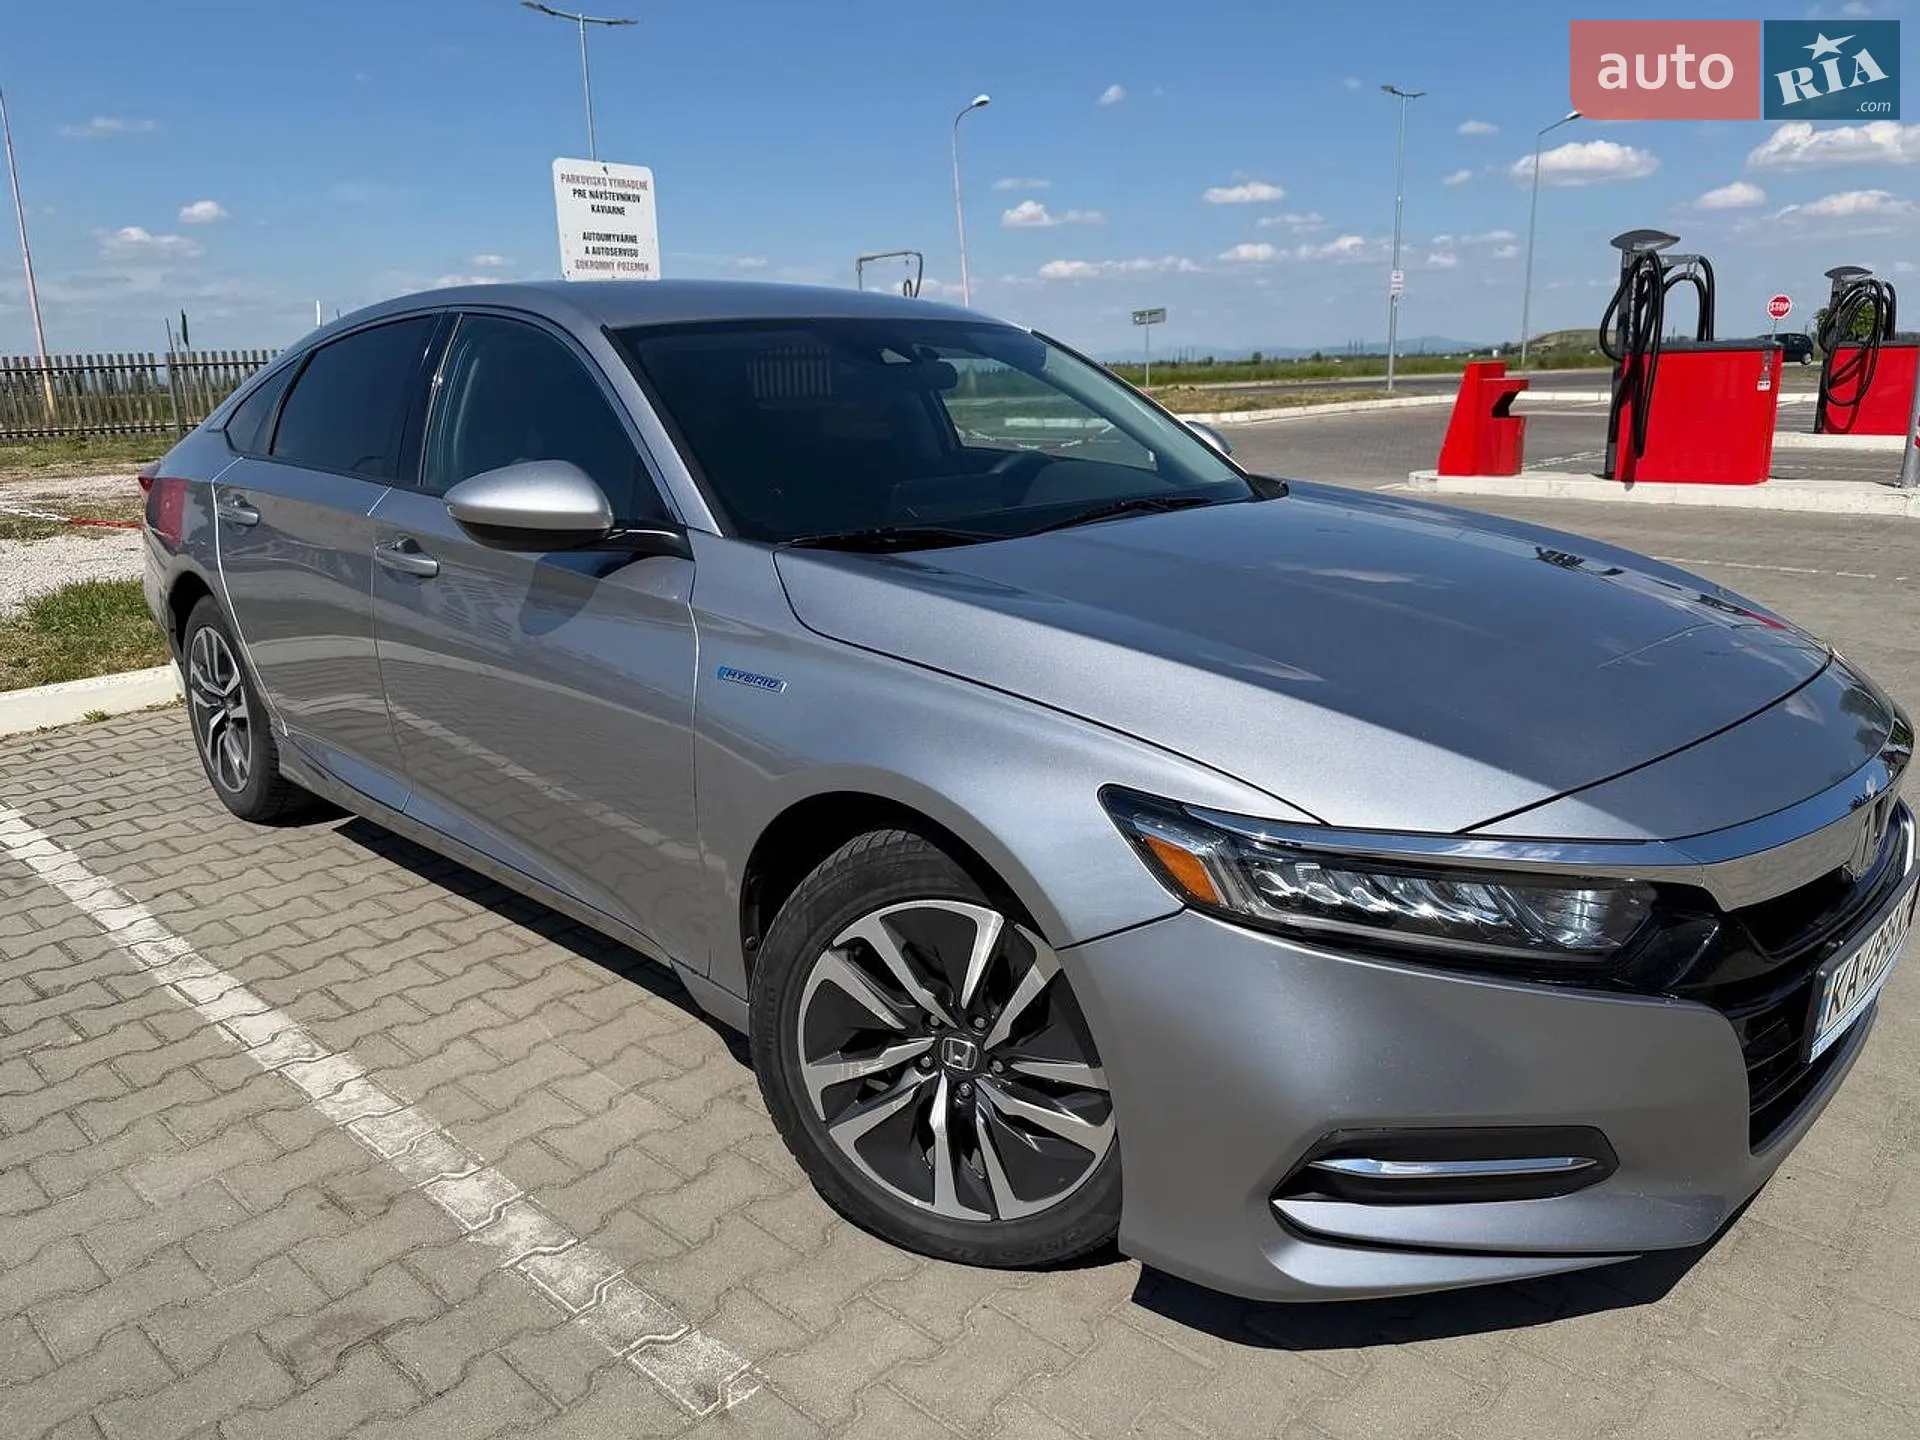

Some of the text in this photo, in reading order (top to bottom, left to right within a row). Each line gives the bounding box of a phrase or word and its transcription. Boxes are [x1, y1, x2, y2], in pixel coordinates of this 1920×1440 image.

[572, 188, 587, 199] PRE
[591, 204, 625, 216] KAVIARNE
[585, 246, 639, 257] A AUTOSERVISU
[1769, 301, 1789, 312] STOP
[726, 668, 778, 688] HYBRID
